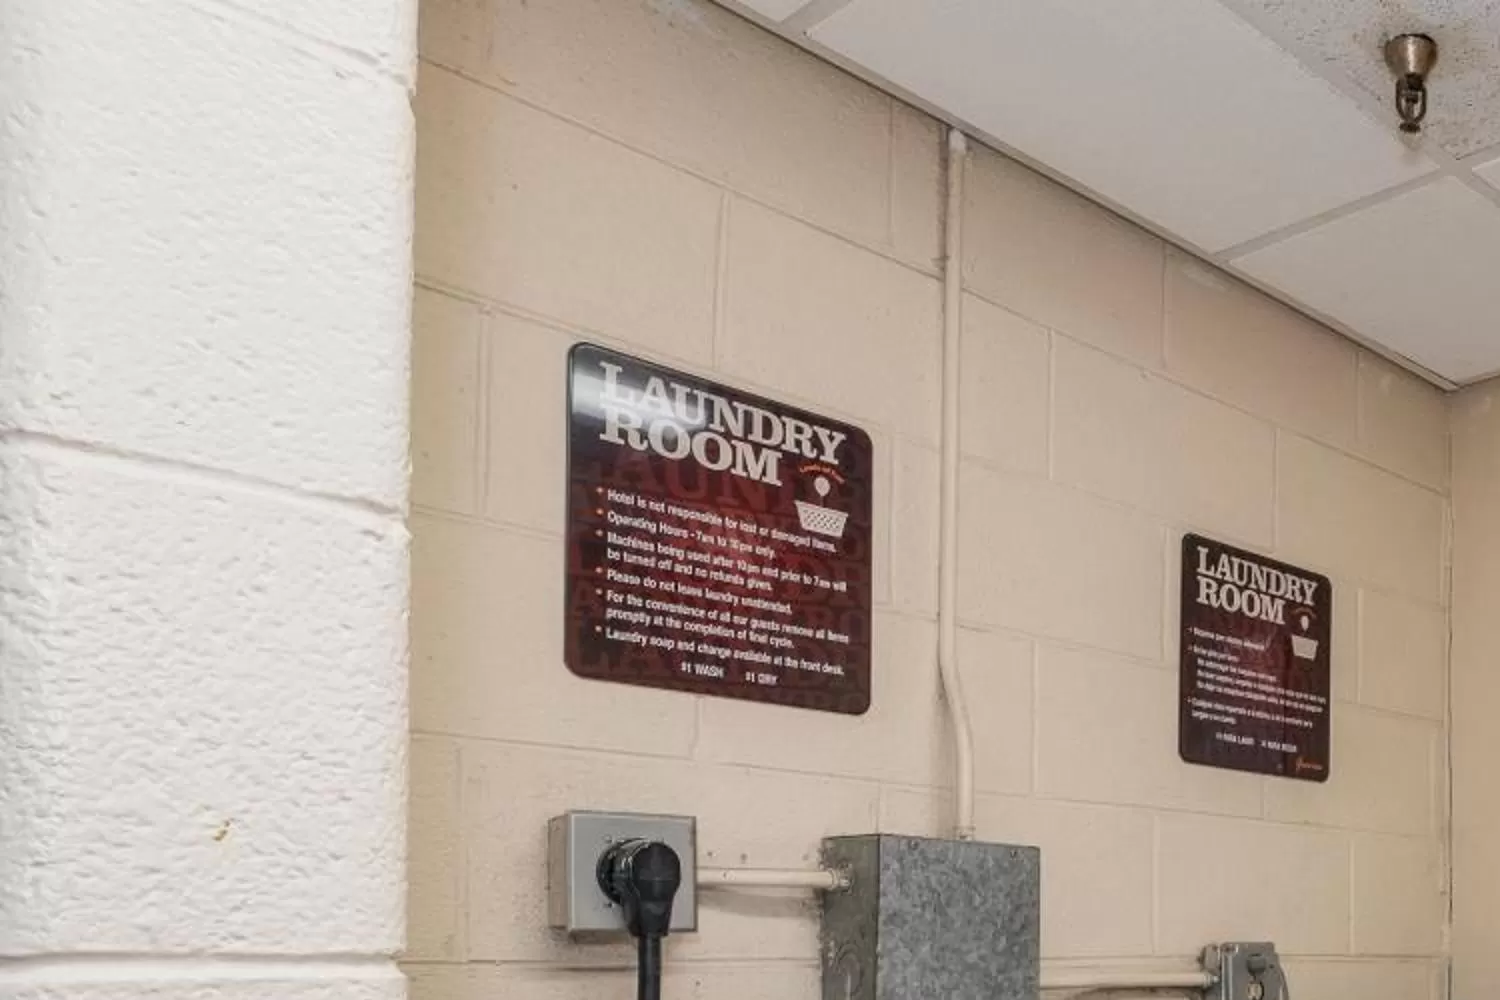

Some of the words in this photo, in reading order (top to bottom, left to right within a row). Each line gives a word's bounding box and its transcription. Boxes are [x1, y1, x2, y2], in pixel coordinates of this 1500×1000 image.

[600, 361, 846, 465] LAUNDRY
[600, 404, 783, 487] ROOM
[607, 489, 635, 505] Hotel
[637, 496, 647, 509] is
[648, 501, 665, 513] not
[667, 505, 723, 526] responsible
[724, 516, 739, 529] for
[759, 527, 769, 537] or
[771, 528, 811, 547] damaged
[607, 510, 657, 534] Operating
[659, 521, 688, 539] Hours
[717, 536, 727, 547] to
[607, 531, 655, 552] Machines
[657, 543, 685, 561] being
[686, 550, 711, 563] used
[713, 554, 733, 569] after
[762, 566, 779, 578] and
[780, 570, 801, 582] prior
[803, 573, 812, 585] to
[607, 548, 621, 561] be
[623, 552, 656, 569] turned
[657, 559, 673, 571] off
[673, 563, 693, 575] and
[694, 567, 708, 578] no
[1196, 546, 1319, 606] LAUNDRY
[607, 568, 641, 585] Please
[643, 576, 657, 589] do
[659, 581, 675, 593] not
[677, 582, 703, 598] leave
[705, 588, 739, 607] laundry
[1196, 575, 1286, 625] ROOM
[606, 608, 651, 627] promptly
[653, 615, 664, 627] at
[665, 617, 682, 629] the
[683, 621, 735, 639] completion
[737, 630, 747, 640] of
[607, 589, 624, 603] For
[626, 594, 644, 607] the
[645, 599, 706, 618] convenience
[707, 609, 719, 620] of
[719, 610, 731, 623] all
[749, 618, 781, 631] guests
[782, 624, 814, 638] remove
[606, 627, 648, 647] Laundry
[649, 636, 675, 650] soap
[677, 641, 695, 652] and
[697, 643, 732, 659] change
[733, 649, 772, 665] available
[773, 656, 783, 666] at
[784, 656, 798, 669] the
[799, 658, 821, 673] front
[694, 664, 724, 678] WASH
